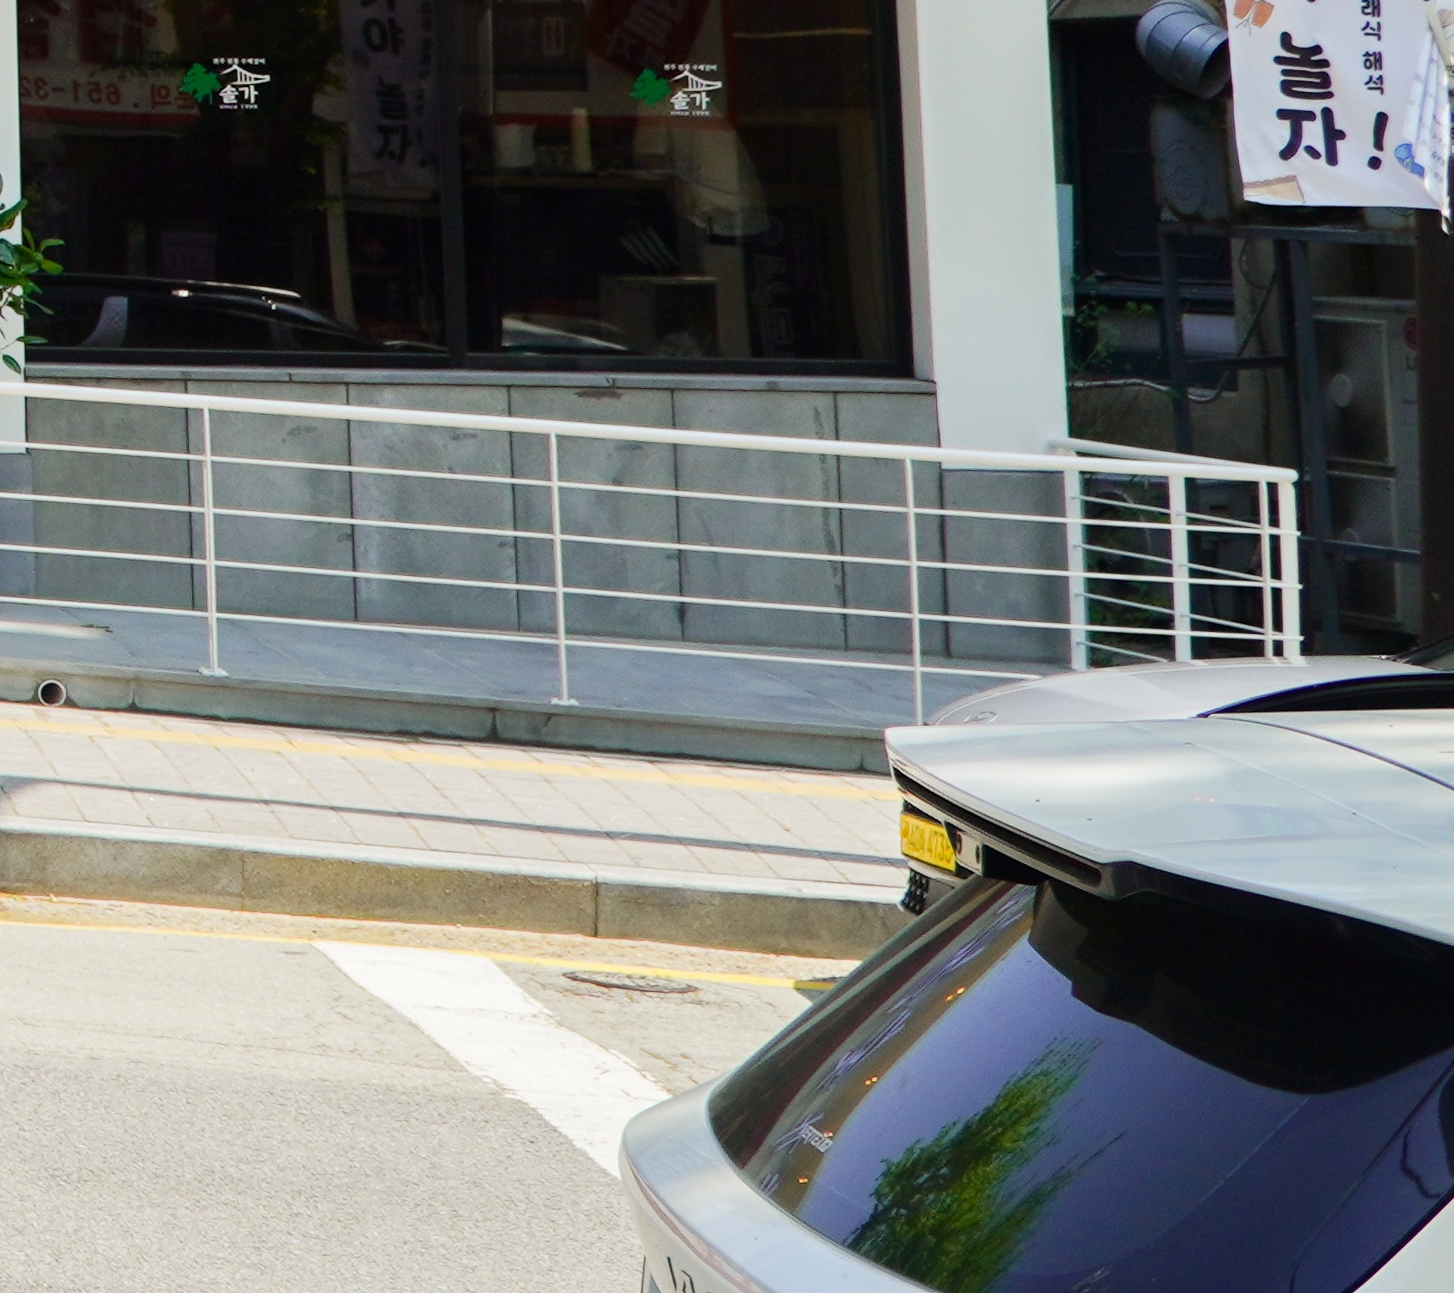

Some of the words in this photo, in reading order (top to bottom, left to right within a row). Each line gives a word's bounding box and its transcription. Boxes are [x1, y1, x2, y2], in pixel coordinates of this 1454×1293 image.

[1362, 50, 1385, 96] 해석
[219, 85, 259, 104] 솔가
[670, 91, 711, 110] 솔가
